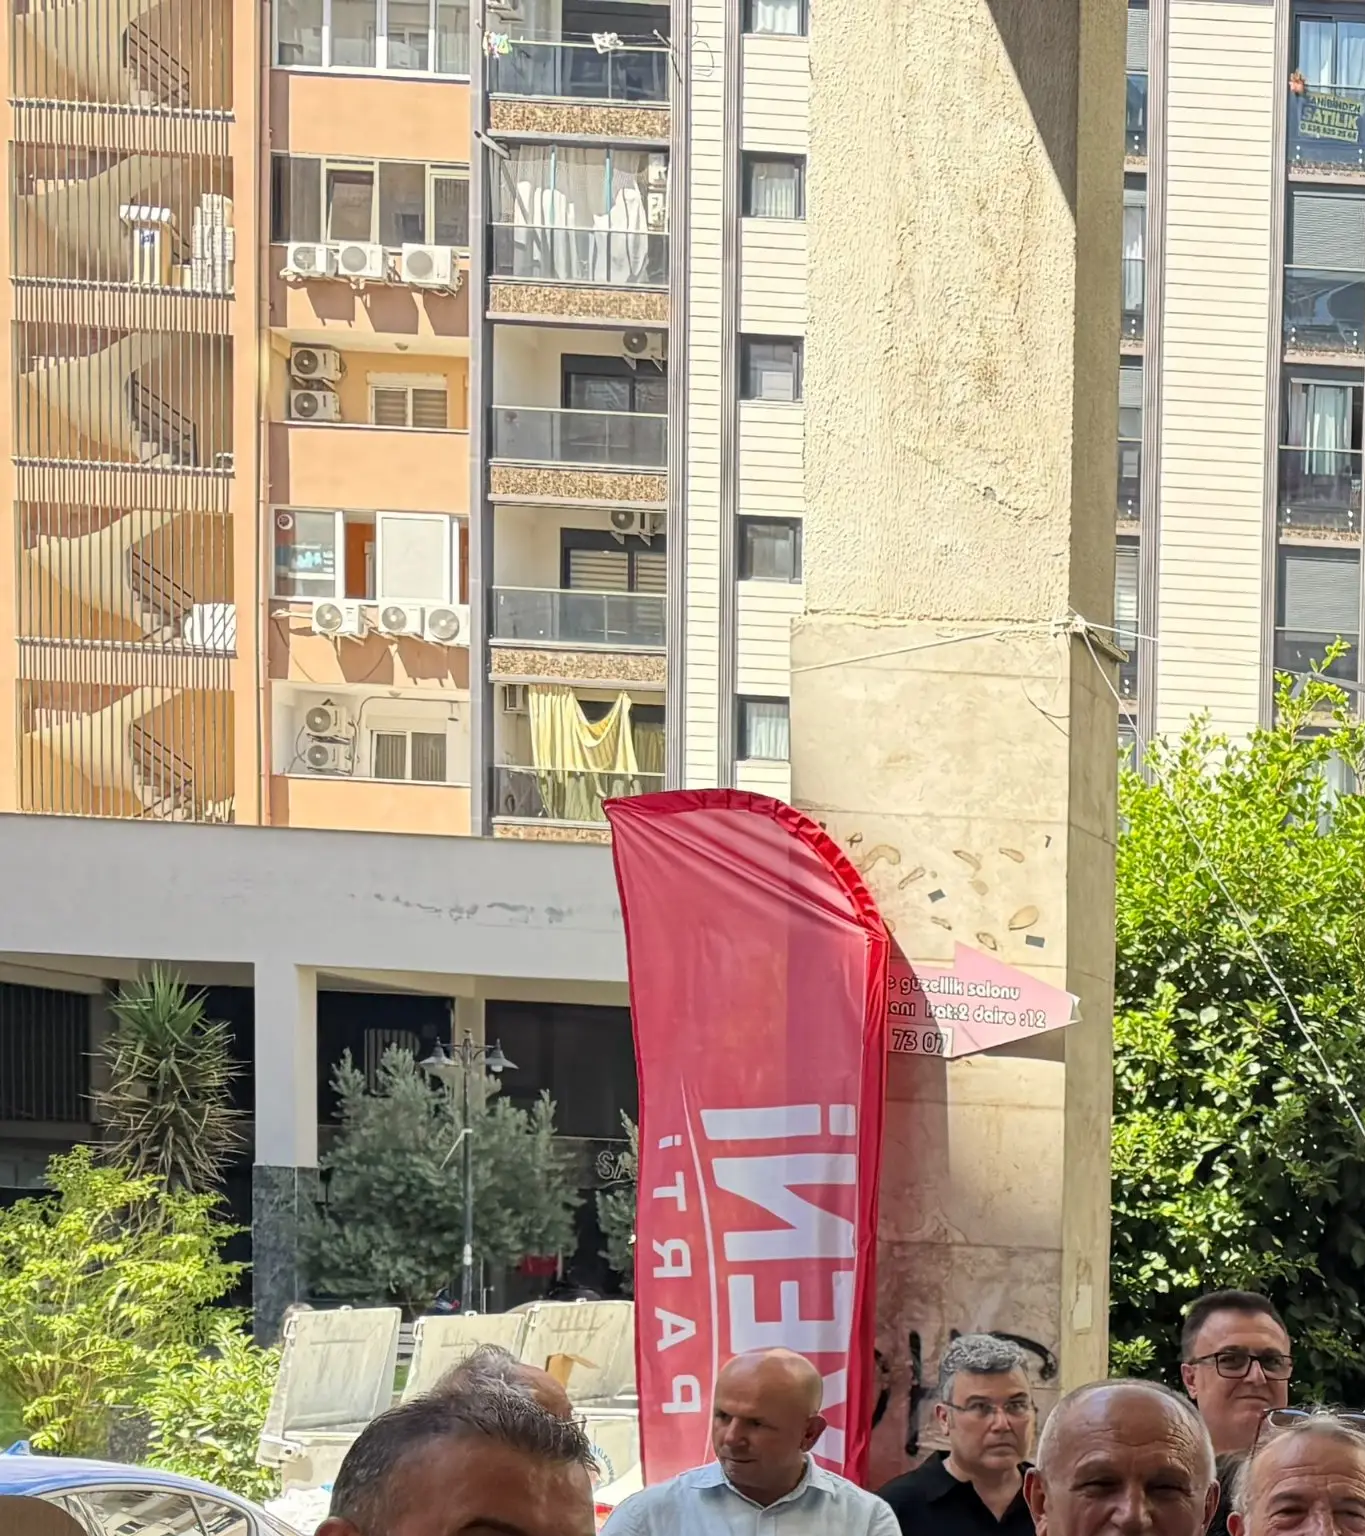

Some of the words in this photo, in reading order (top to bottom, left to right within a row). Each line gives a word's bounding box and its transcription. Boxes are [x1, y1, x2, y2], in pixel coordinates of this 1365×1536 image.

[1302, 106, 1358, 129] SATILIK
[967, 980, 1020, 1000] salonu
[887, 1001, 915, 1016] anı
[973, 1005, 1016, 1026] daire
[892, 1028, 917, 1051] 73
